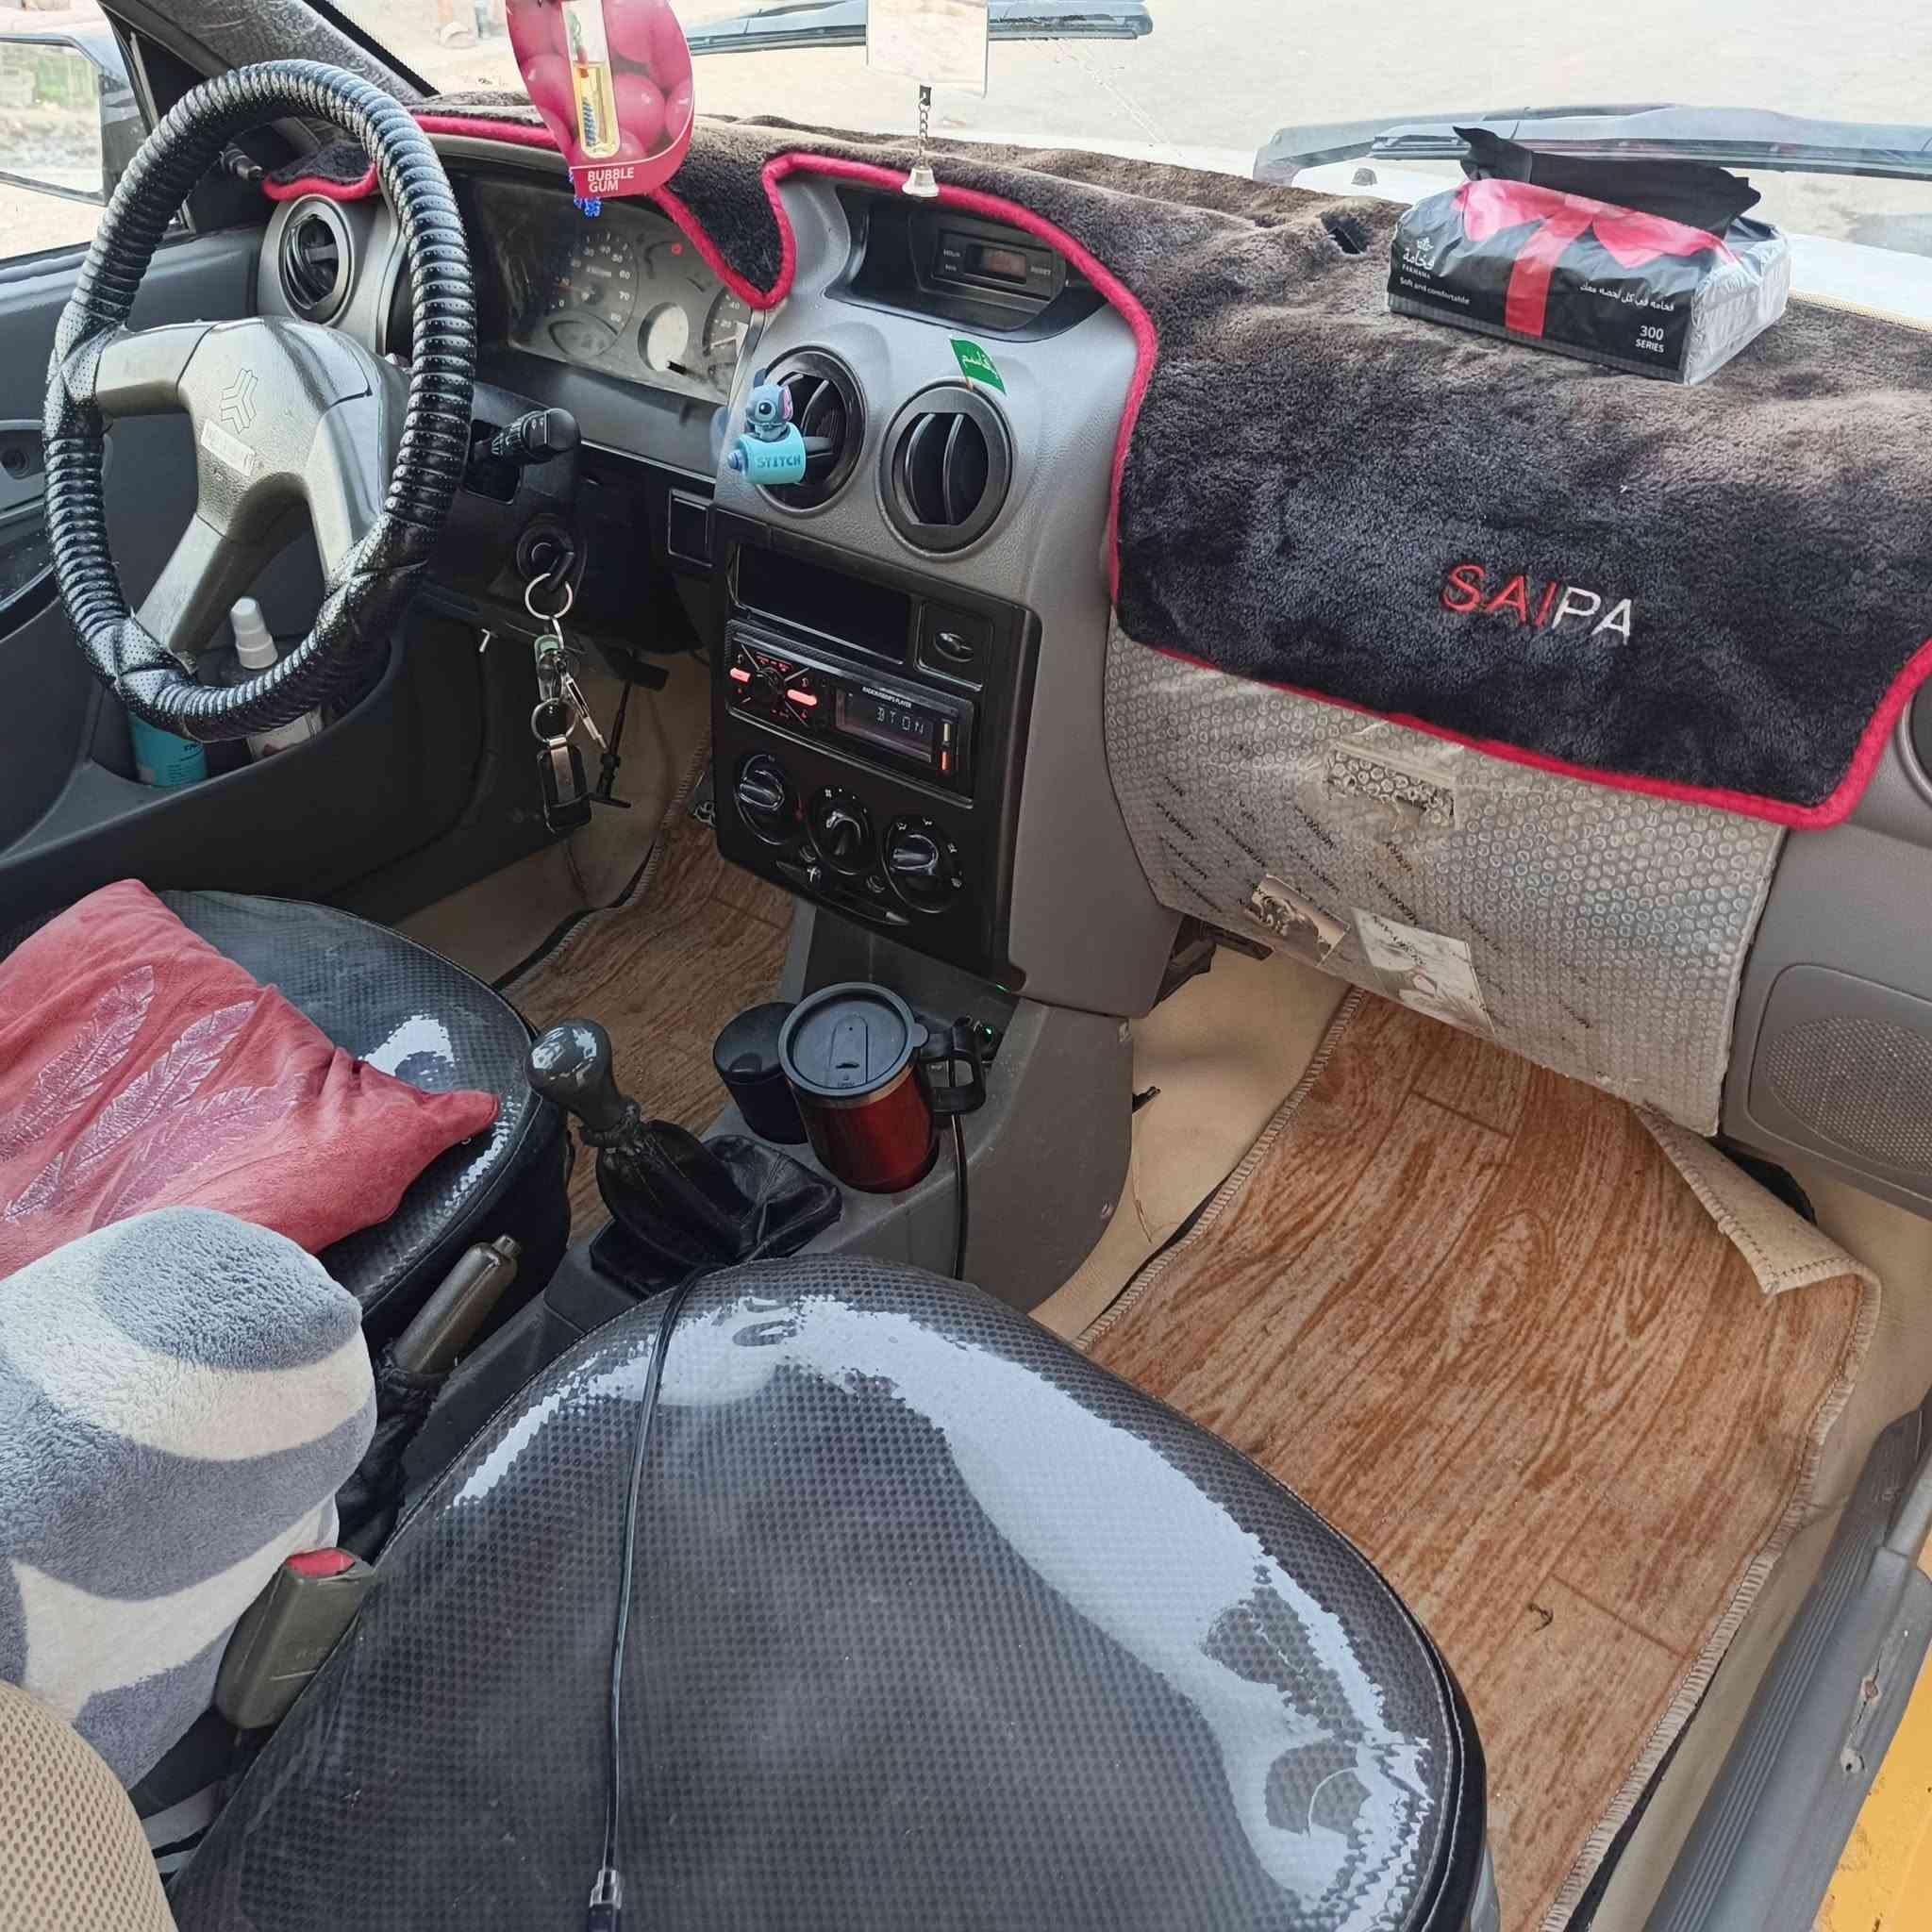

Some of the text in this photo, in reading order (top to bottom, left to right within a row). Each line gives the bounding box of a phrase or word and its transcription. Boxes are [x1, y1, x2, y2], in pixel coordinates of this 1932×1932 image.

[588, 167, 635, 182] BUBBLE
[589, 180, 619, 193] GUM
[619, 270, 631, 280] 60
[618, 291, 631, 302] 70
[1639, 325, 1664, 341] 300
[1635, 338, 1665, 354] SERIES
[756, 455, 802, 470] STITCH
[1441, 564, 1633, 646] SAIPA
